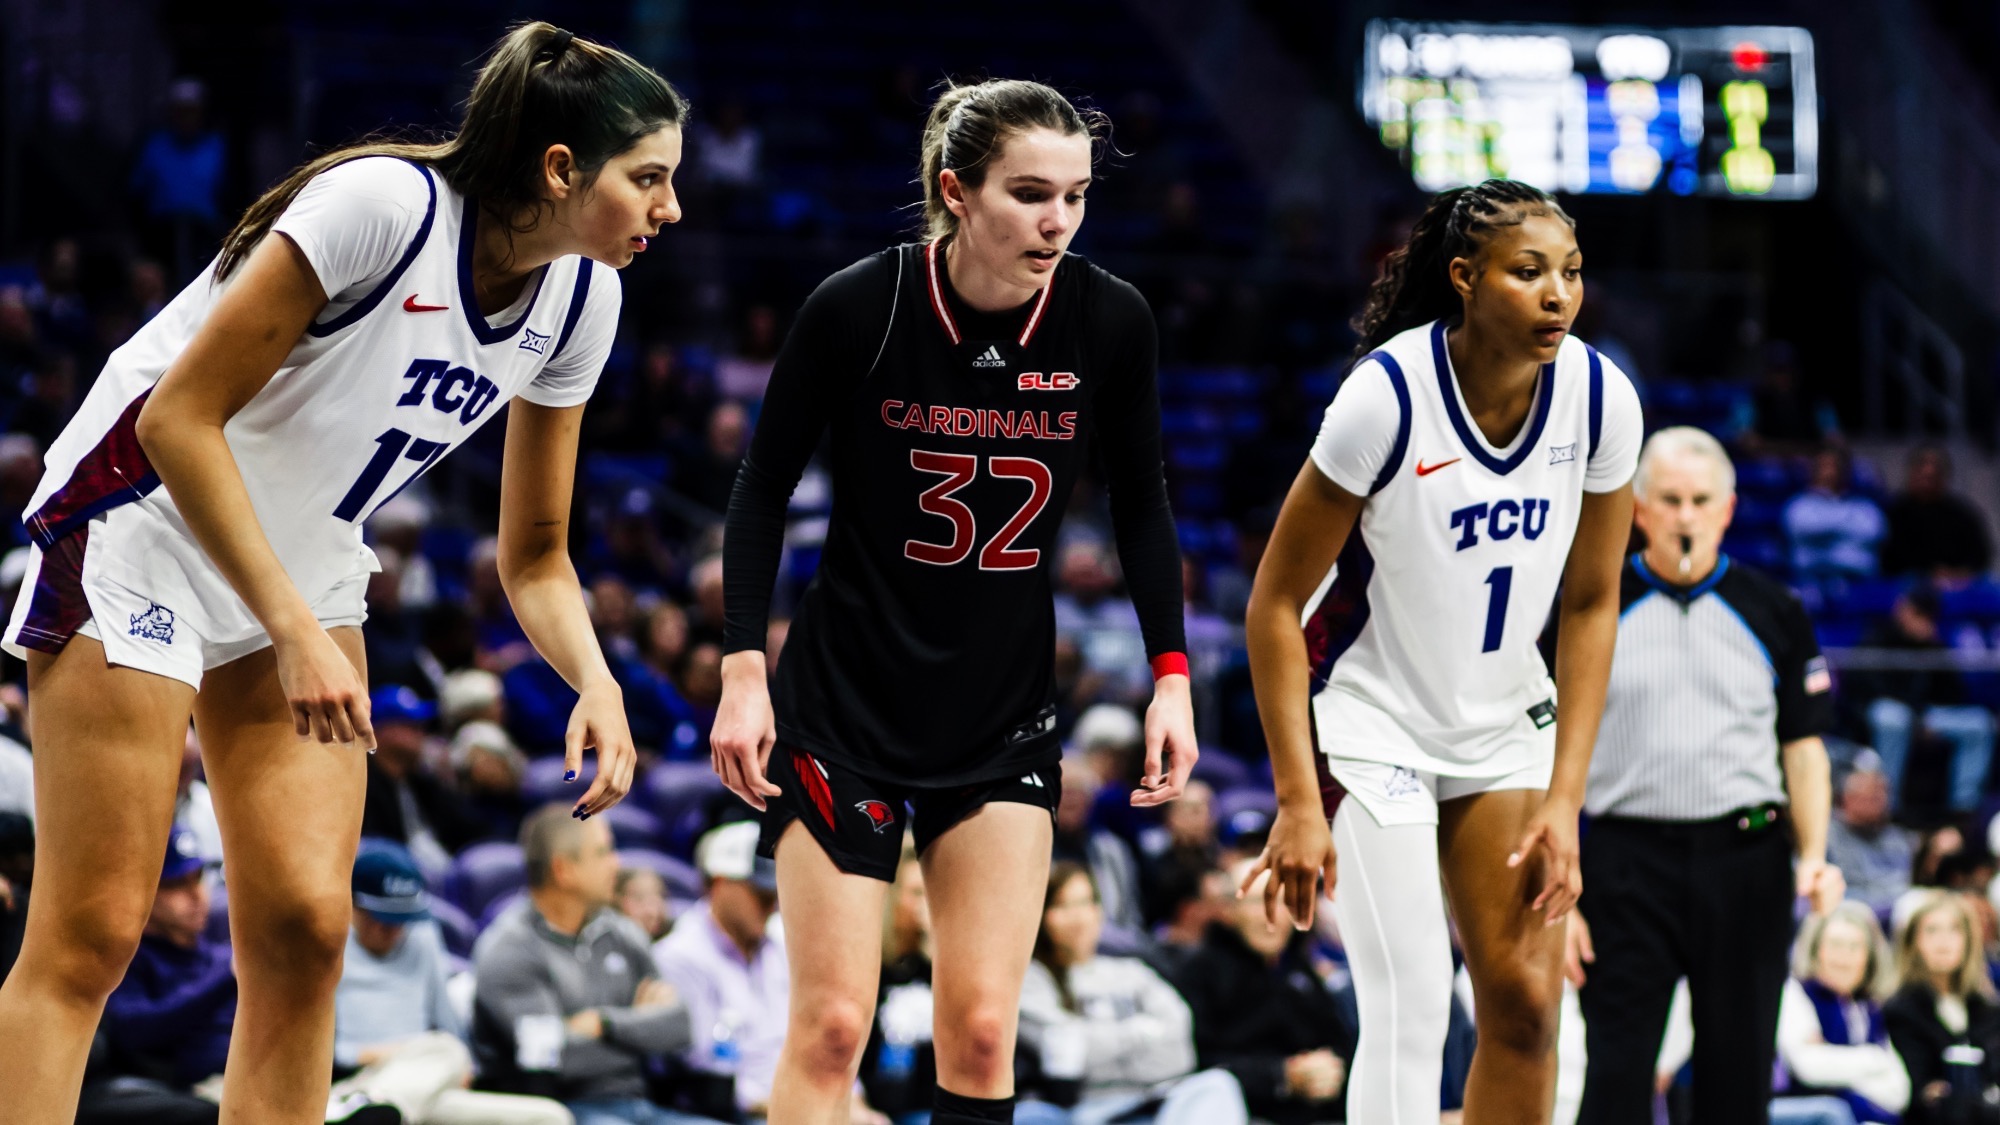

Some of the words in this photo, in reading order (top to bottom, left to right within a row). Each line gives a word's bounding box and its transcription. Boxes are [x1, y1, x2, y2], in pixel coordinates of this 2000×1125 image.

[396, 358, 500, 427] TCU
[881, 399, 1078, 440] CARDINALS
[332, 427, 452, 526] 17
[904, 449, 1053, 571] 32
[1450, 498, 1551, 553] TCU
[1482, 565, 1514, 653] 1
